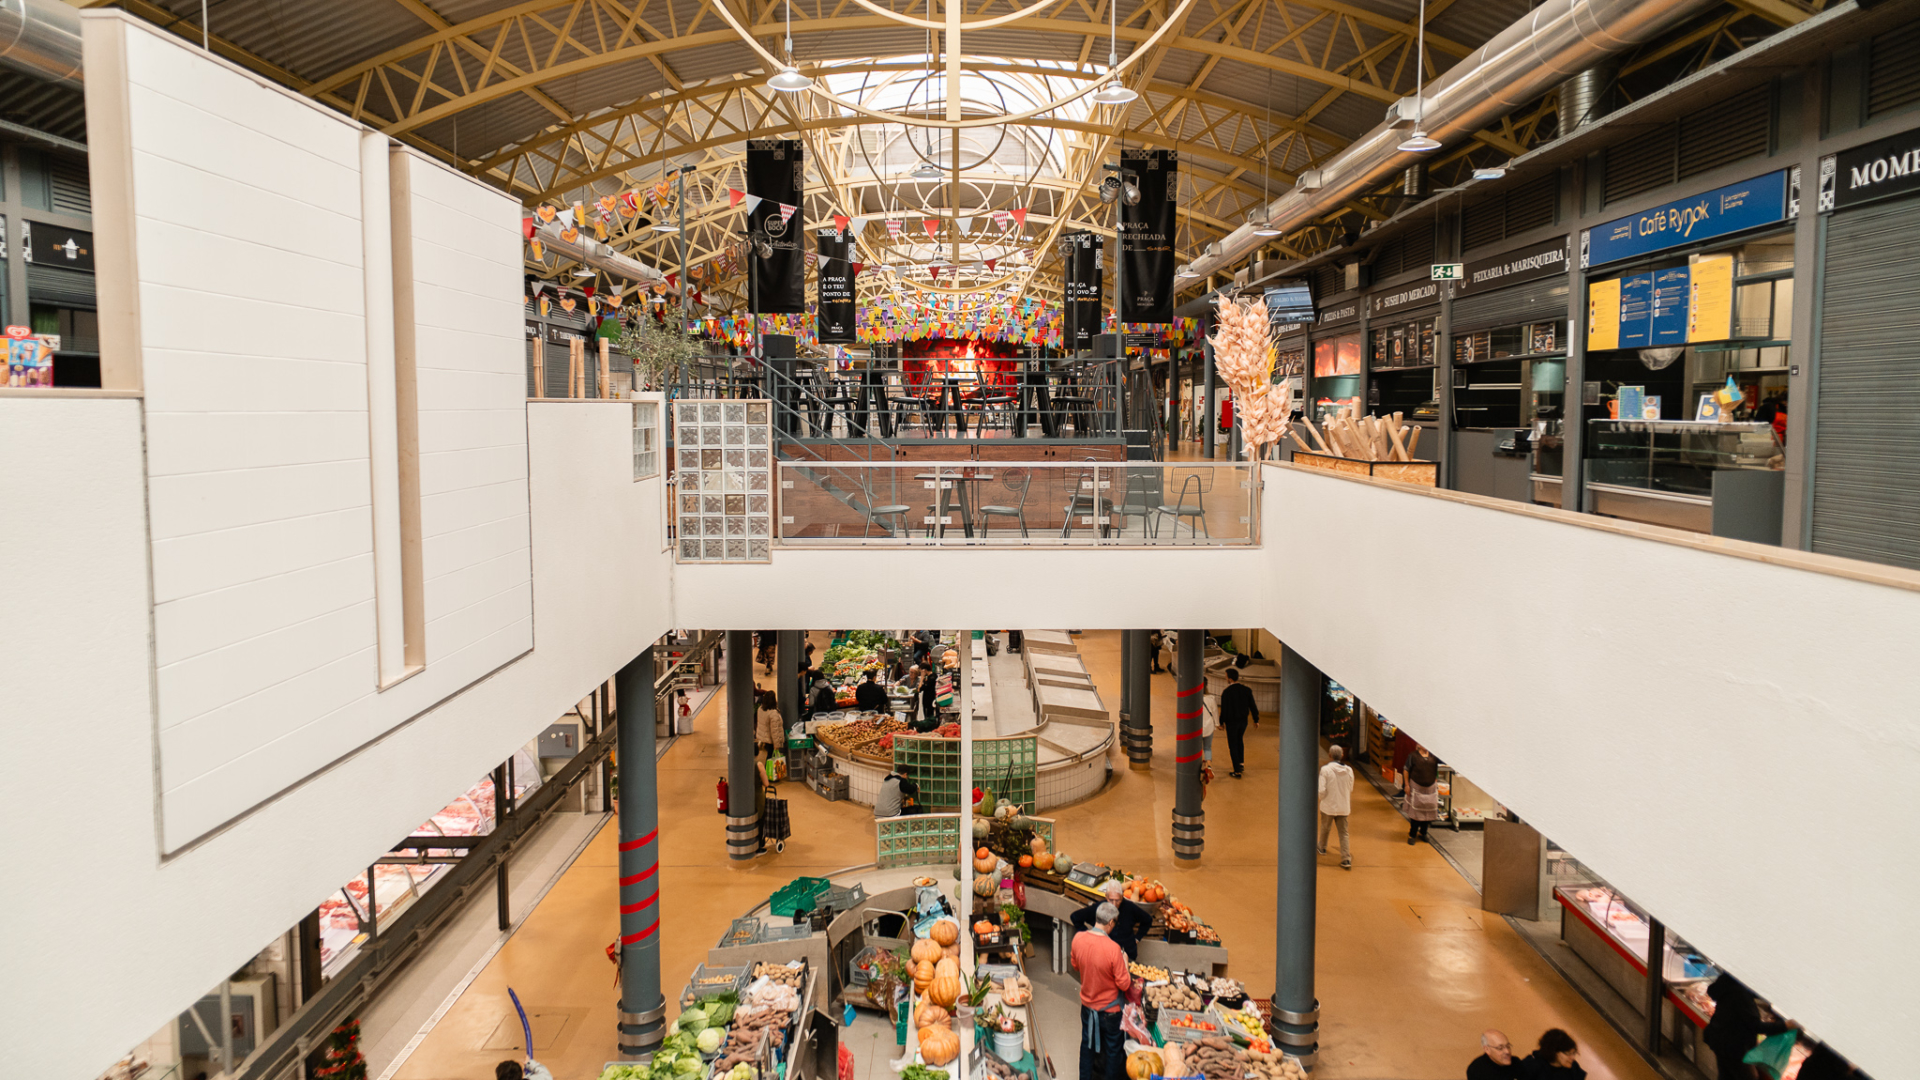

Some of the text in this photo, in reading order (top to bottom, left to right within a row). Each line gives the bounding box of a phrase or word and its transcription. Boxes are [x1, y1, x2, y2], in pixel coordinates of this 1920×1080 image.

[1122, 222, 1149, 231] PRAÇA
[1639, 200, 1710, 238] Café Rynok
[1122, 233, 1167, 241] RECHEADA
[1473, 248, 1564, 283] PEIXARIA & MARISQUEIRA
[1384, 284, 1437, 308] SUSHI DO MERCADO
